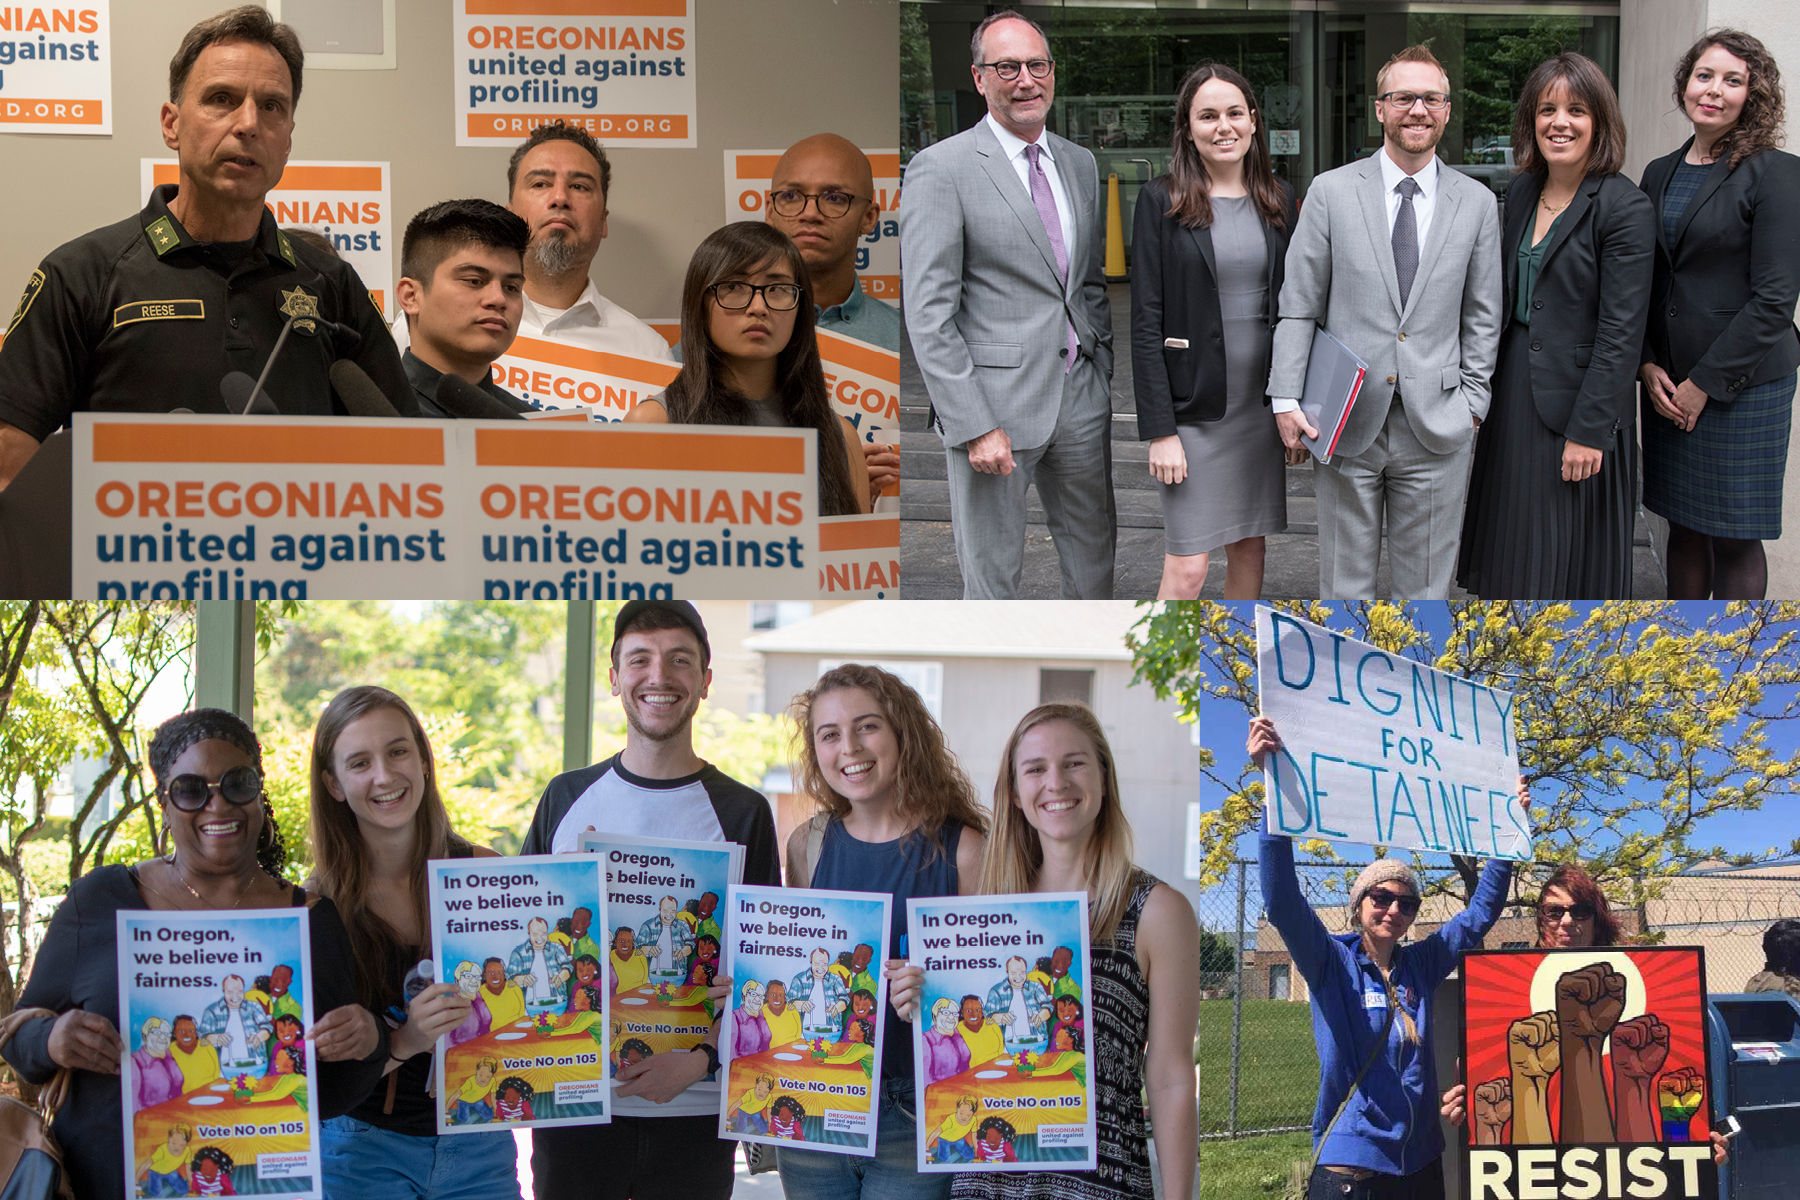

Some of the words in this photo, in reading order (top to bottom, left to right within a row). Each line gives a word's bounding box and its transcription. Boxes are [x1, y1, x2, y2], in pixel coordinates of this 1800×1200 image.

[467, 26, 685, 50] OREGONIANS
[468, 52, 566, 76] united
[575, 53, 685, 81] against
[469, 80, 598, 108] profiling
[141, 304, 175, 318] REESE
[491, 362, 653, 411] OREGONI
[95, 480, 445, 519] OREGONIANS
[480, 483, 803, 526] OREGONIANS
[96, 522, 256, 562] united
[270, 522, 446, 570] against
[482, 524, 627, 564] united
[640, 529, 804, 574] against
[97, 568, 308, 600] profiling
[483, 569, 674, 600] profiling
[1271, 612, 1513, 756] DIGNITY
[1381, 728, 1441, 771] FOR
[1271, 746, 1533, 861] DETAINEES
[609, 850, 675, 868] Oregon,
[443, 875, 461, 889] In
[466, 873, 539, 890] Oregon,
[617, 870, 676, 887] believe
[680, 874, 695, 888] in
[444, 898, 473, 911] we
[478, 894, 542, 910] believe
[547, 891, 564, 906] in
[606, 889, 656, 906] rness.
[740, 900, 756, 913] In
[760, 901, 826, 919] Oregon,
[446, 918, 524, 934] fairness.
[922, 914, 940, 927] In
[944, 912, 1018, 928] Oregon,
[134, 928, 152, 942] In
[157, 928, 235, 945] Oregon,
[740, 923, 763, 934] we
[768, 922, 827, 938] believe
[832, 925, 848, 940] in
[923, 938, 951, 948] we
[956, 932, 1022, 948] believe
[1026, 930, 1044, 945] in
[134, 952, 163, 964] we
[169, 948, 238, 964] believe
[244, 946, 262, 963] in
[740, 940, 806, 958] fairness.
[924, 955, 1002, 971] fairness.
[134, 972, 218, 988] fairness.
[627, 1022, 652, 1033] Vote
[655, 1023, 672, 1034] NO
[674, 1026, 688, 1034] on
[690, 1025, 708, 1035] 105
[504, 1058, 532, 1069] Vote
[536, 1056, 554, 1067] NO
[558, 1056, 573, 1066] on
[576, 1054, 597, 1064] 105
[579, 1088, 599, 1096] against
[779, 1079, 806, 1090] Vote
[808, 1081, 826, 1092] NO
[829, 1086, 844, 1094] on
[846, 1086, 866, 1096] 105
[984, 1098, 1014, 1108] Vote
[1017, 1098, 1037, 1108] NO
[1040, 1098, 1056, 1107] on
[1060, 1097, 1082, 1106] 105
[828, 1112, 866, 1120] OREGONIANS
[198, 1126, 230, 1138] Vote
[234, 1125, 256, 1136] NO
[259, 1126, 276, 1135] on
[280, 1122, 304, 1134] 105
[1469, 1146, 1711, 1200] RESIST
